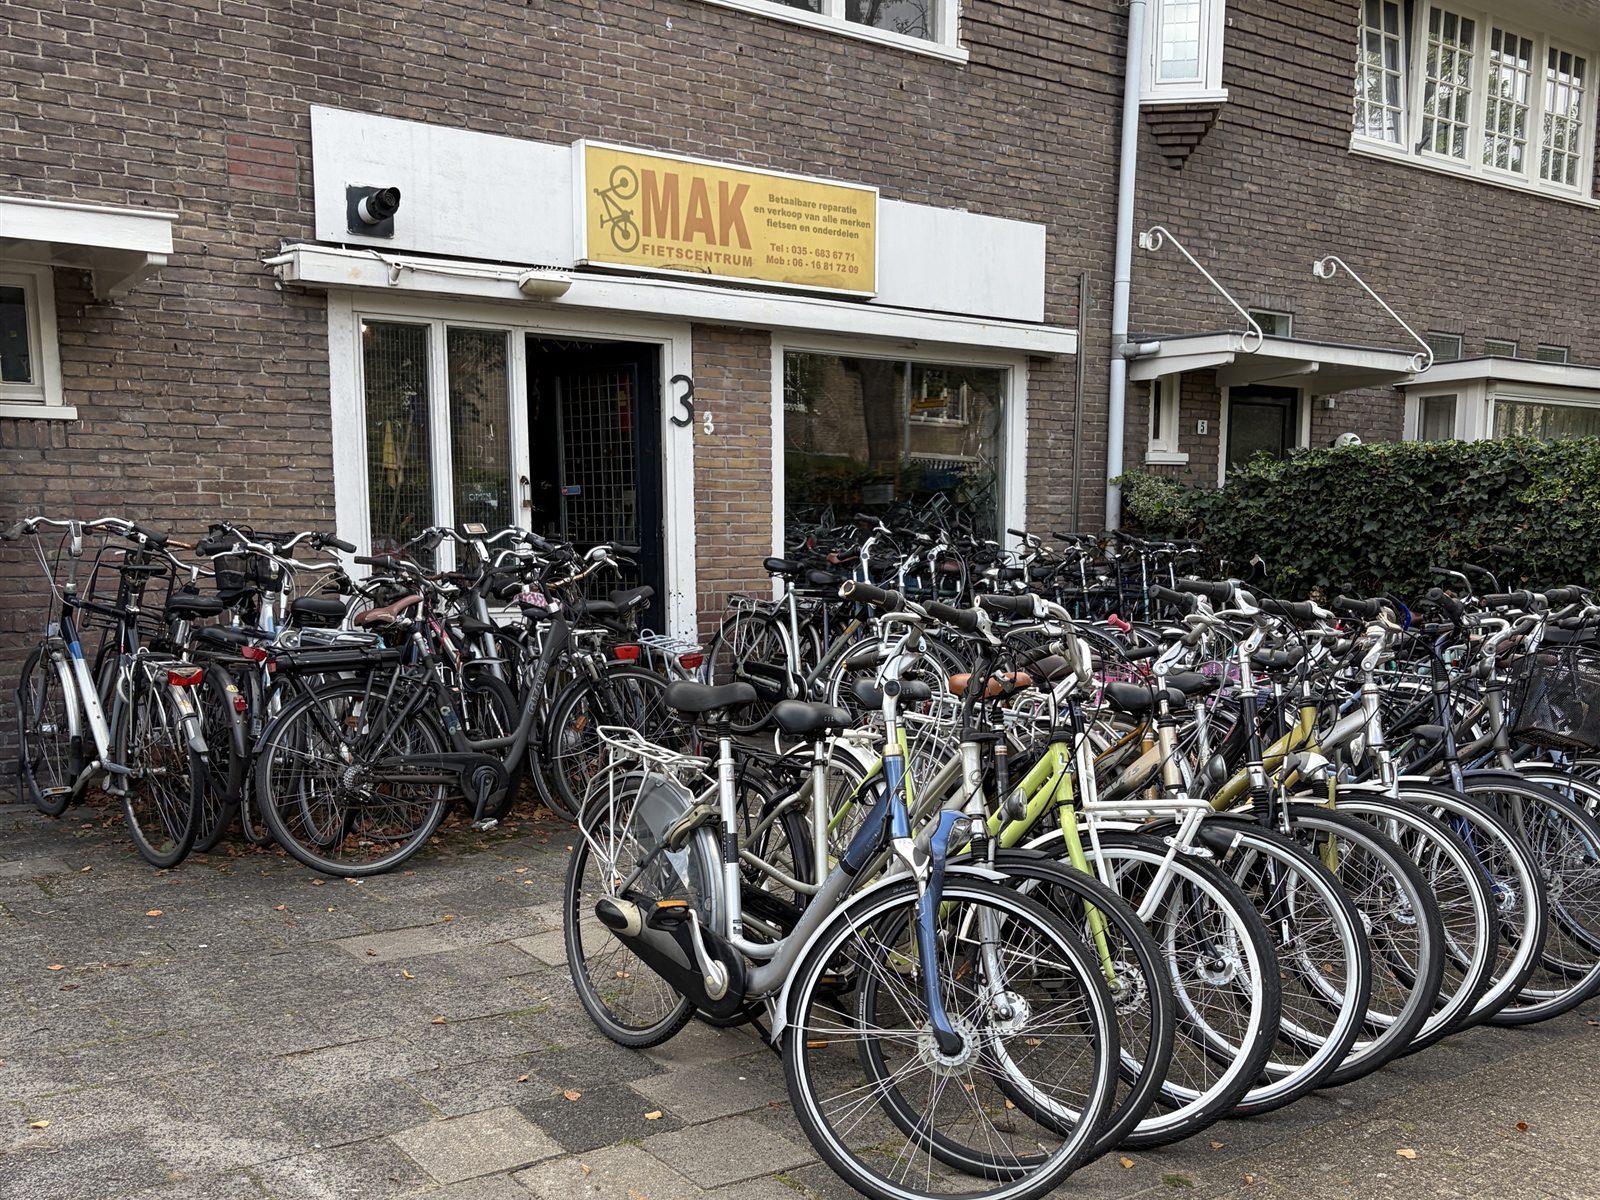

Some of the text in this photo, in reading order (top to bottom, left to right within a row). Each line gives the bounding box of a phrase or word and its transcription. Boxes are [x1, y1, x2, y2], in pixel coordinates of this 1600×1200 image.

[641, 168, 752, 250] MAK
[768, 193, 858, 215] Betaalbare reparatie
[753, 205, 871, 229] en verkoop van alle merken
[766, 218, 859, 239] fietsen en onderdelen
[642, 244, 753, 267] FIETSCENTRUM
[770, 242, 784, 253] Tel
[791, 245, 807, 256] 035
[815, 248, 831, 259] 683
[832, 251, 843, 260] 67
[845, 252, 855, 262] 71
[766, 254, 785, 265] Mob
[792, 258, 803, 267] 06
[811, 260, 821, 270] 16
[823, 262, 834, 271] 81
[836, 263, 846, 273] 72
[848, 265, 859, 274] 09
[670, 374, 694, 428] 3
[703, 411, 714, 435] 3
[527, 660, 549, 715] GITANE
